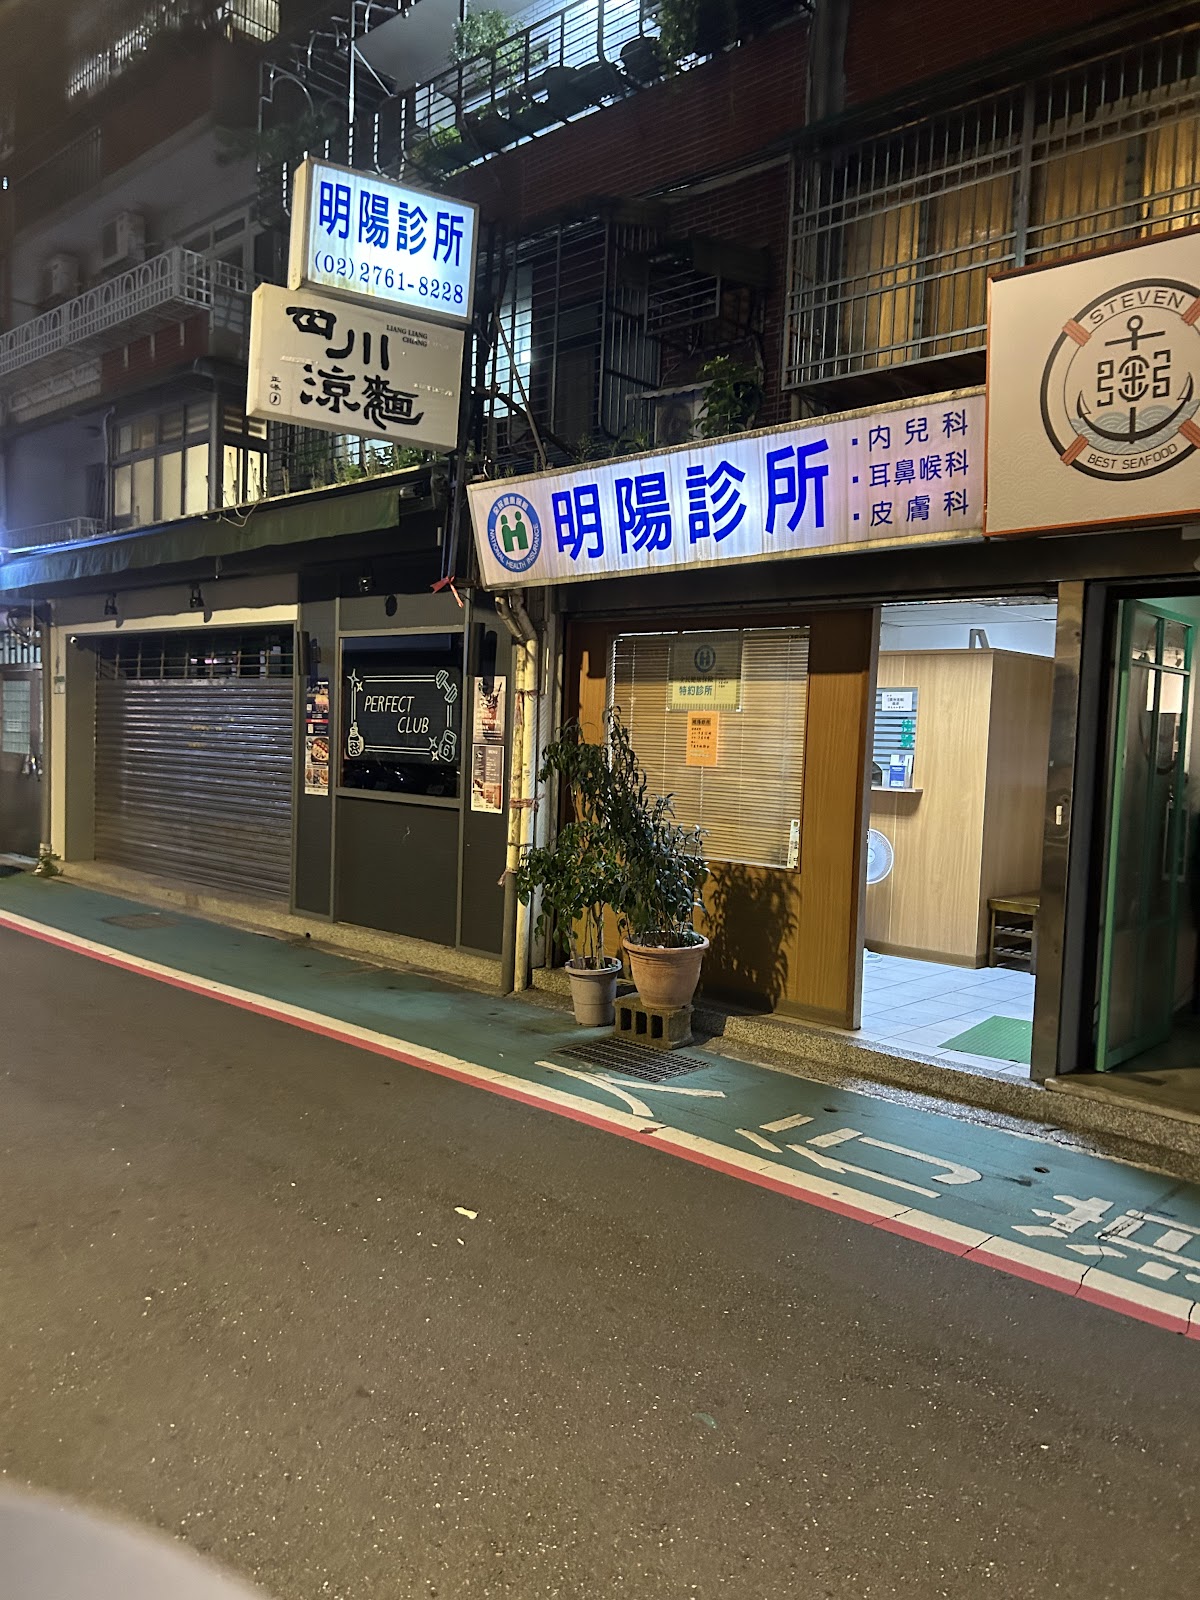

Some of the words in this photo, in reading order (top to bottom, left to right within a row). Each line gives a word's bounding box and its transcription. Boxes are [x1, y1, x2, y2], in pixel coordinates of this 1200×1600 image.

[318, 180, 465, 267] 明陽診所
[314, 250, 464, 304] (02)2761-8228
[1089, 289, 1186, 325] STEVEN
[285, 306, 390, 371] 四川
[386, 324, 407, 335] LIANG
[408, 329, 428, 340] LIANG
[299, 363, 425, 431] 涼麵
[868, 448, 969, 488] 耳鼻喉科
[1086, 452, 1118, 470] BEST
[1121, 442, 1179, 470] SEAFOOD
[551, 438, 829, 561] 明陽診所
[869, 488, 969, 527] 皮膚科
[489, 528, 505, 563] NATIONAL
[505, 560, 527, 570] HEALTH
[527, 523, 540, 565] INSURANCE
[363, 695, 415, 713] PERFECT
[678, 685, 713, 696] 特約診所
[397, 716, 430, 734] CLUB
